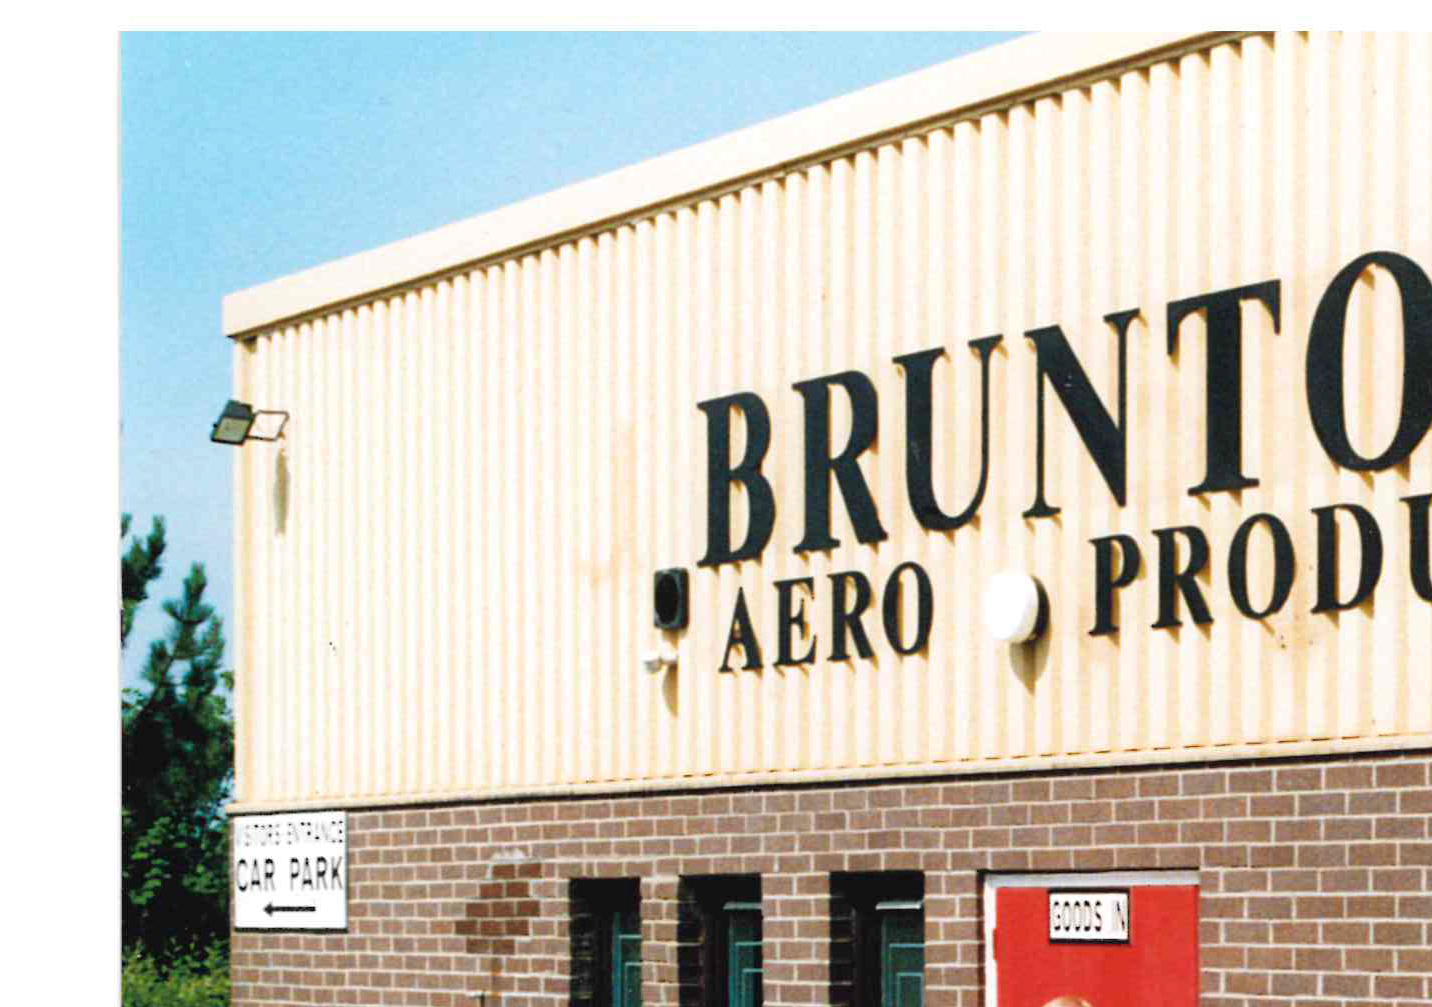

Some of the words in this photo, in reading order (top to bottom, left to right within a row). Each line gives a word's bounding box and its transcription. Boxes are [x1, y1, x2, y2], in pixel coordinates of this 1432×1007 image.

[720, 562, 933, 673] AERO
[235, 824, 281, 847] ISITORS
[236, 857, 276, 893] CAR
[289, 856, 343, 891] PARK
[1052, 899, 1103, 932] GOODS
